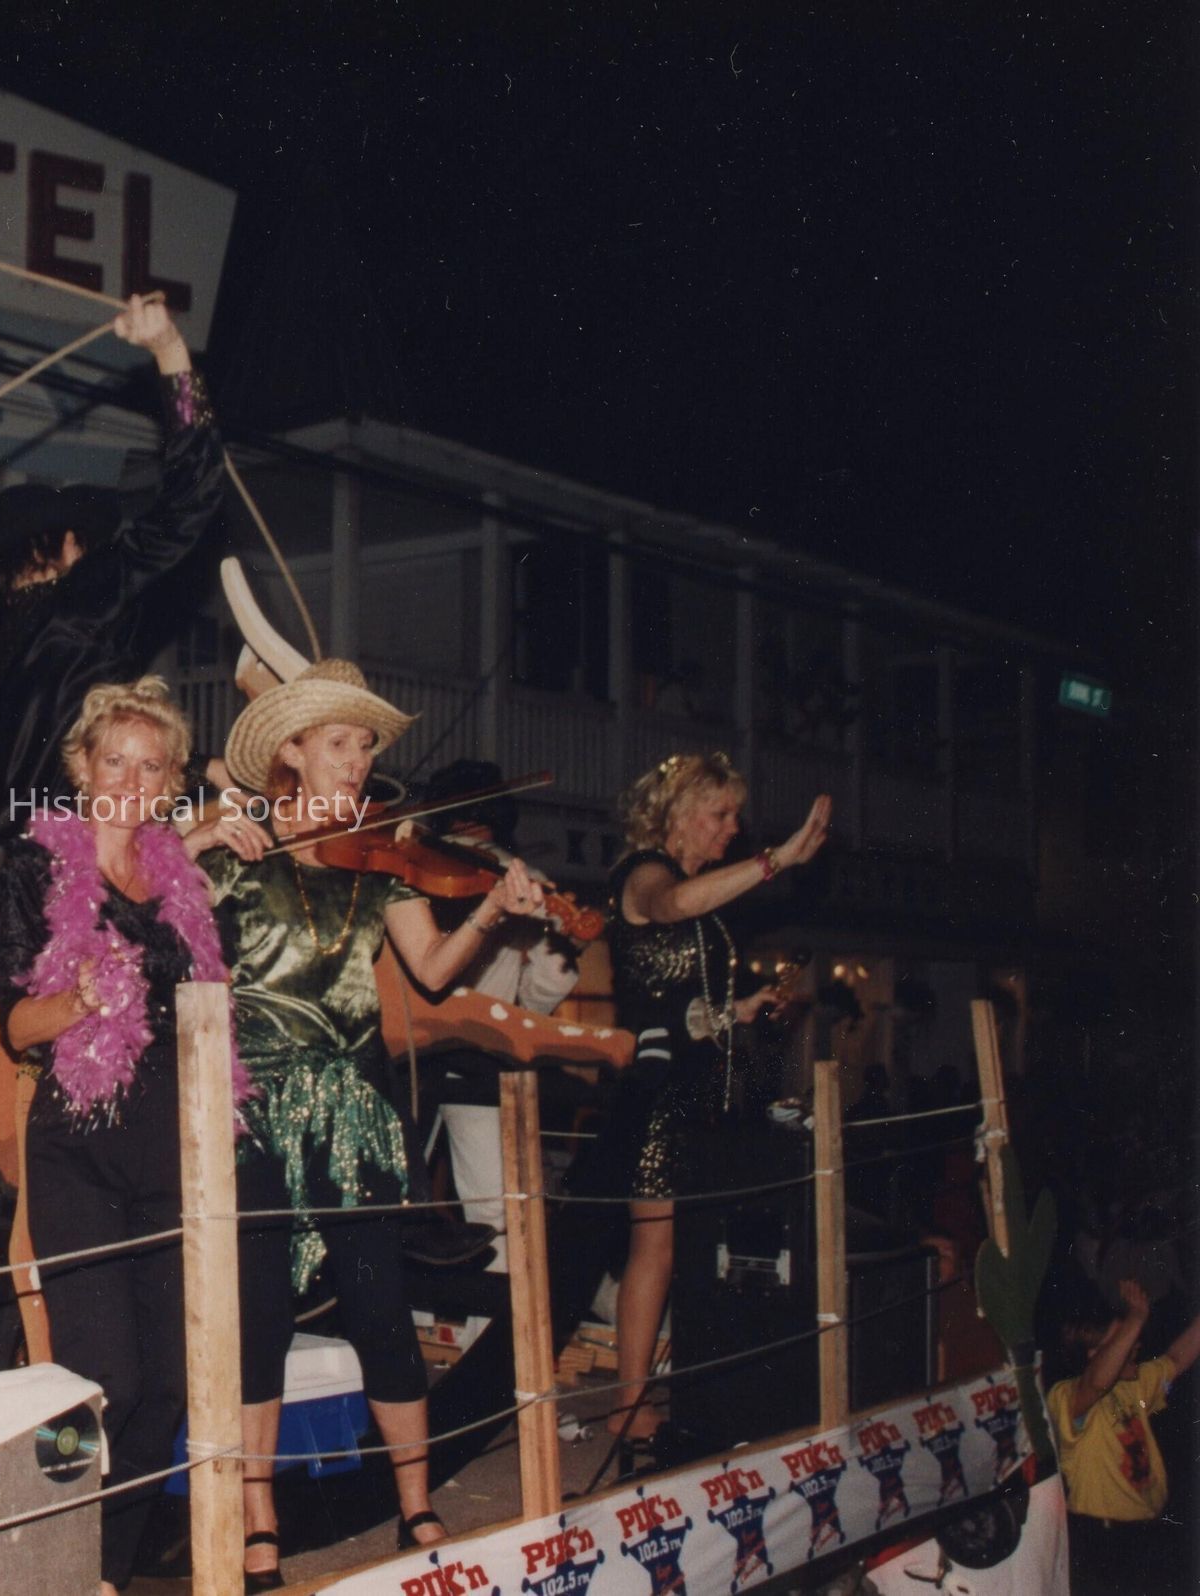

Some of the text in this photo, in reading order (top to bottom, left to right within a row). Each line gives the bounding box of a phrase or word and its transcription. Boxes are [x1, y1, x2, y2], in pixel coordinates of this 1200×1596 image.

[781, 1441, 844, 1479] PIK'n
[701, 1468, 765, 1507] PIK'n
[616, 1495, 683, 1539] PIK'n
[521, 1526, 595, 1574] PIK'n
